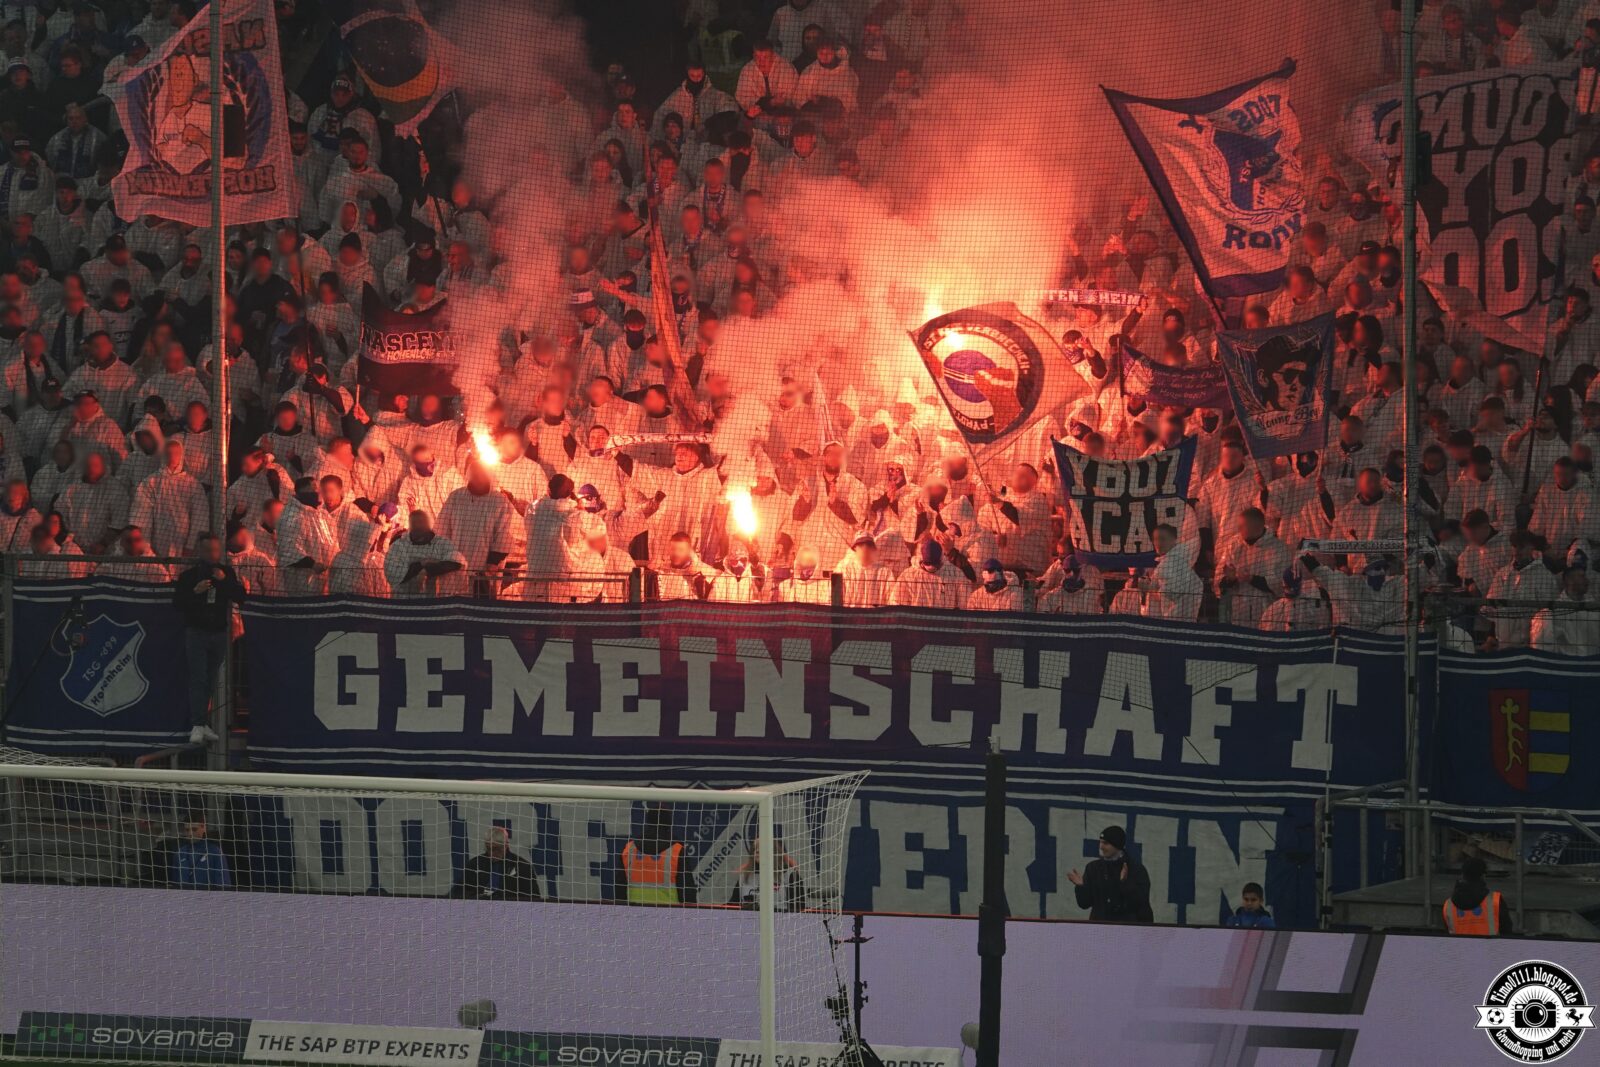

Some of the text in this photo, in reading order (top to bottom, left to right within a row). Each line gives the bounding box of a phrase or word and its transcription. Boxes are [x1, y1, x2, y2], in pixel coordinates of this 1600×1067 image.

[1099, 292, 1140, 305] HEIM
[1066, 448, 1181, 499] YB07
[82, 660, 101, 681] TSG
[313, 630, 1358, 770] GEMEINSCHAFT
[92, 1027, 234, 1048] sovanta
[258, 1034, 470, 1060] THE SAP BTP EXPERTS
[557, 1046, 704, 1067] sovanta
